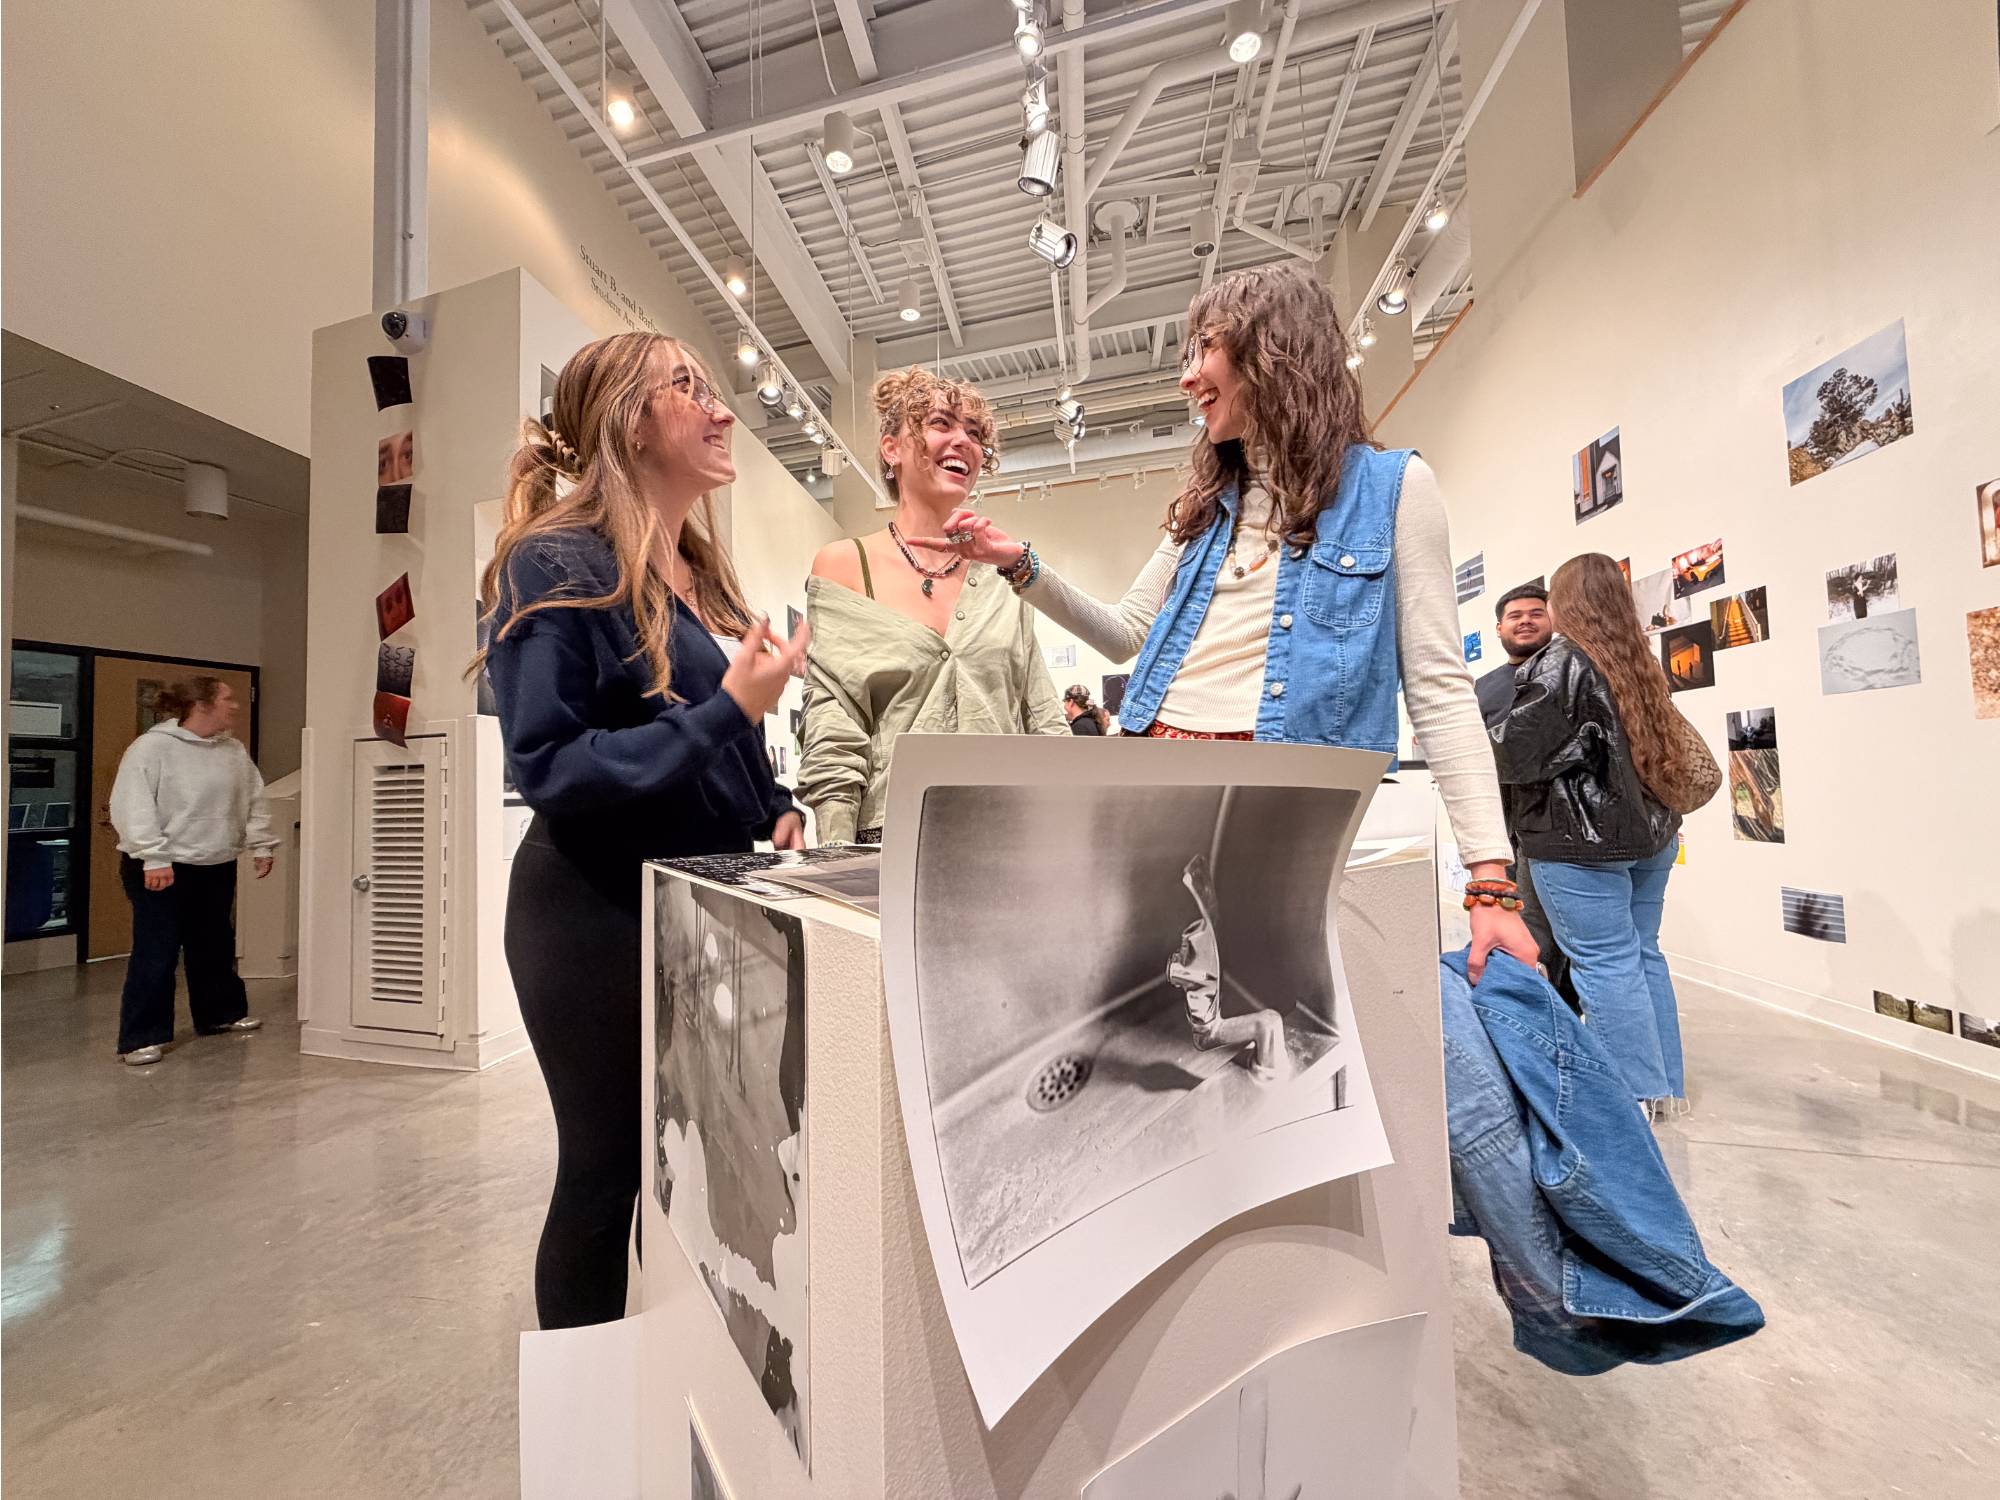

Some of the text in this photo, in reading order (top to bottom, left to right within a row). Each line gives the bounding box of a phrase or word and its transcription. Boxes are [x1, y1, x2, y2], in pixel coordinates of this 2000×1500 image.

[579, 244, 607, 284] Stuart
[609, 275, 619, 296] B.
[620, 292, 636, 314] and
[590, 276, 621, 317] Student
